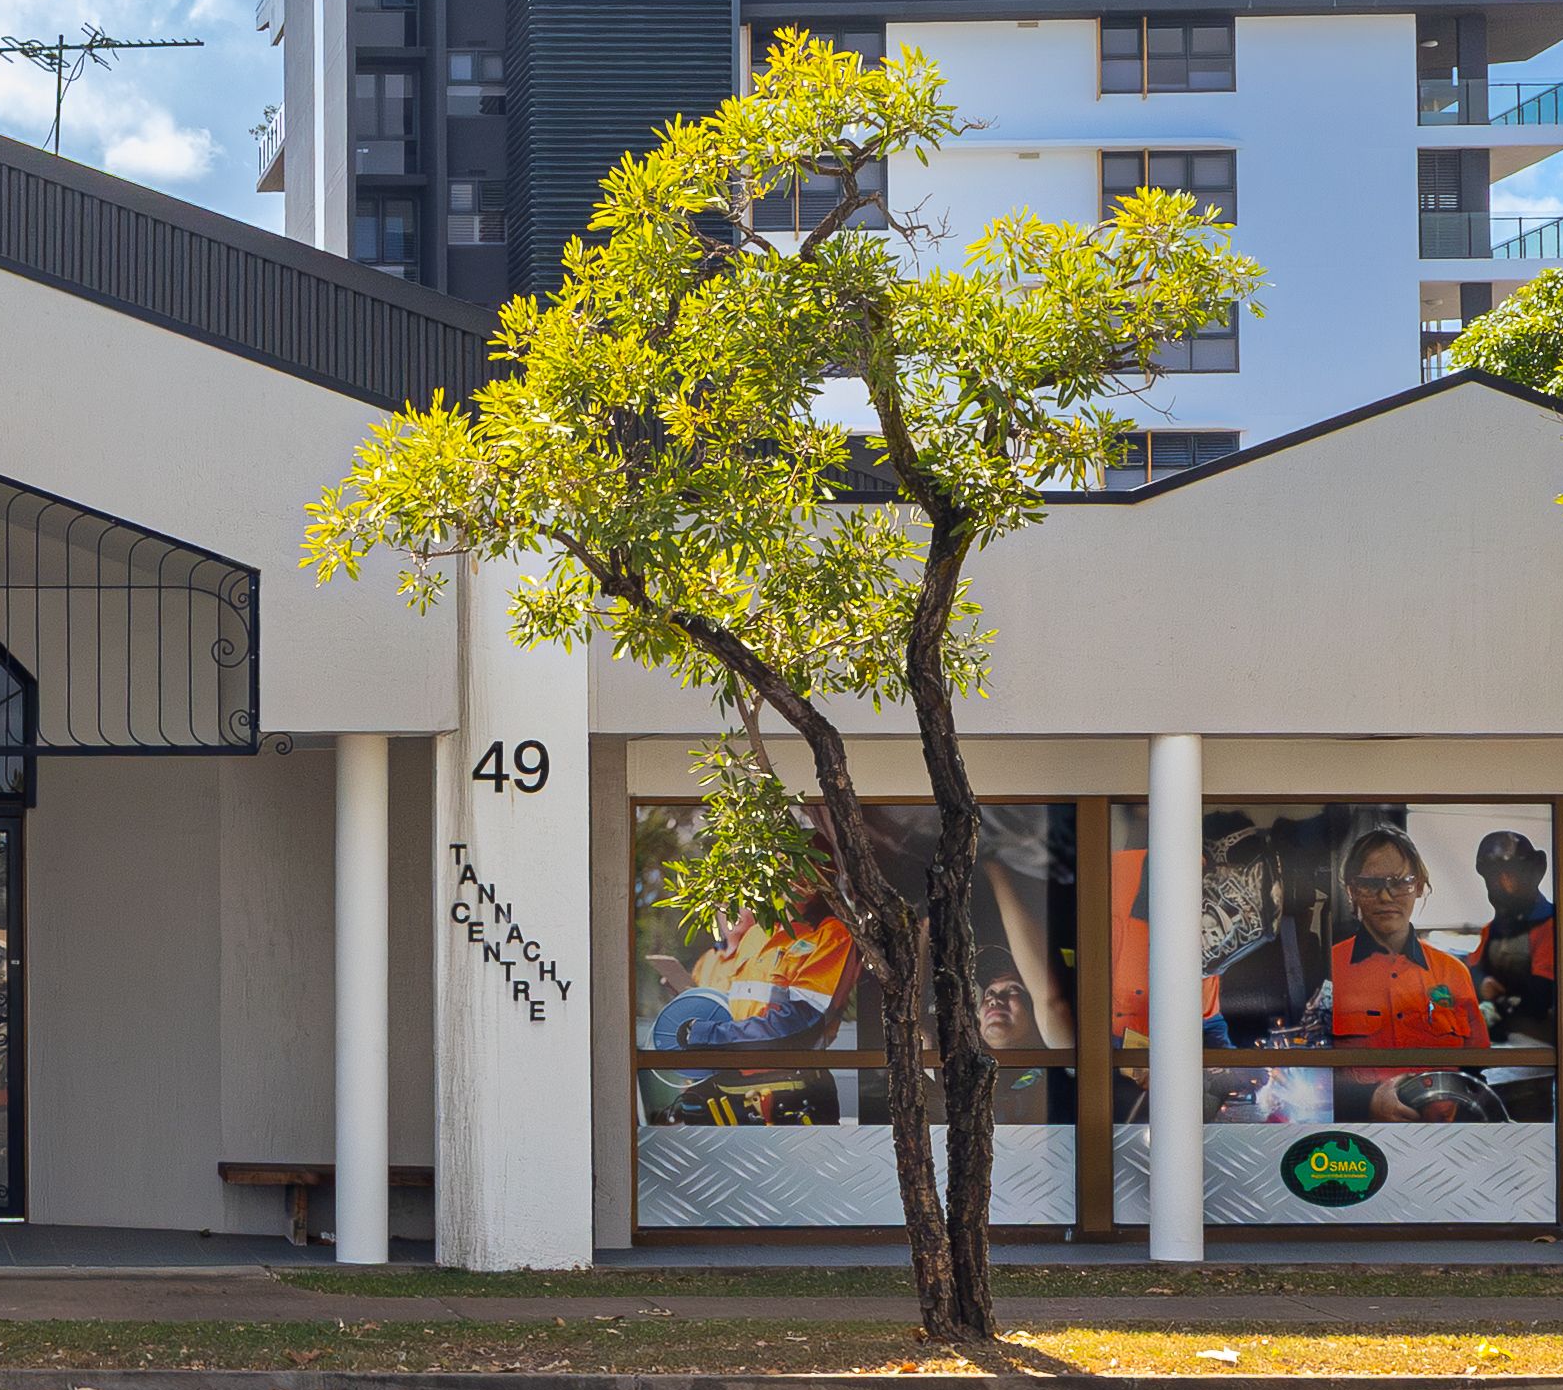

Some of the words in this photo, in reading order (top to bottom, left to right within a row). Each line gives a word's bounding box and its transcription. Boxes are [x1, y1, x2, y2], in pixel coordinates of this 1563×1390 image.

[472, 740, 550, 793] 49
[449, 843, 571, 1001] TANNACHY
[451, 902, 546, 1022] CENTRE
